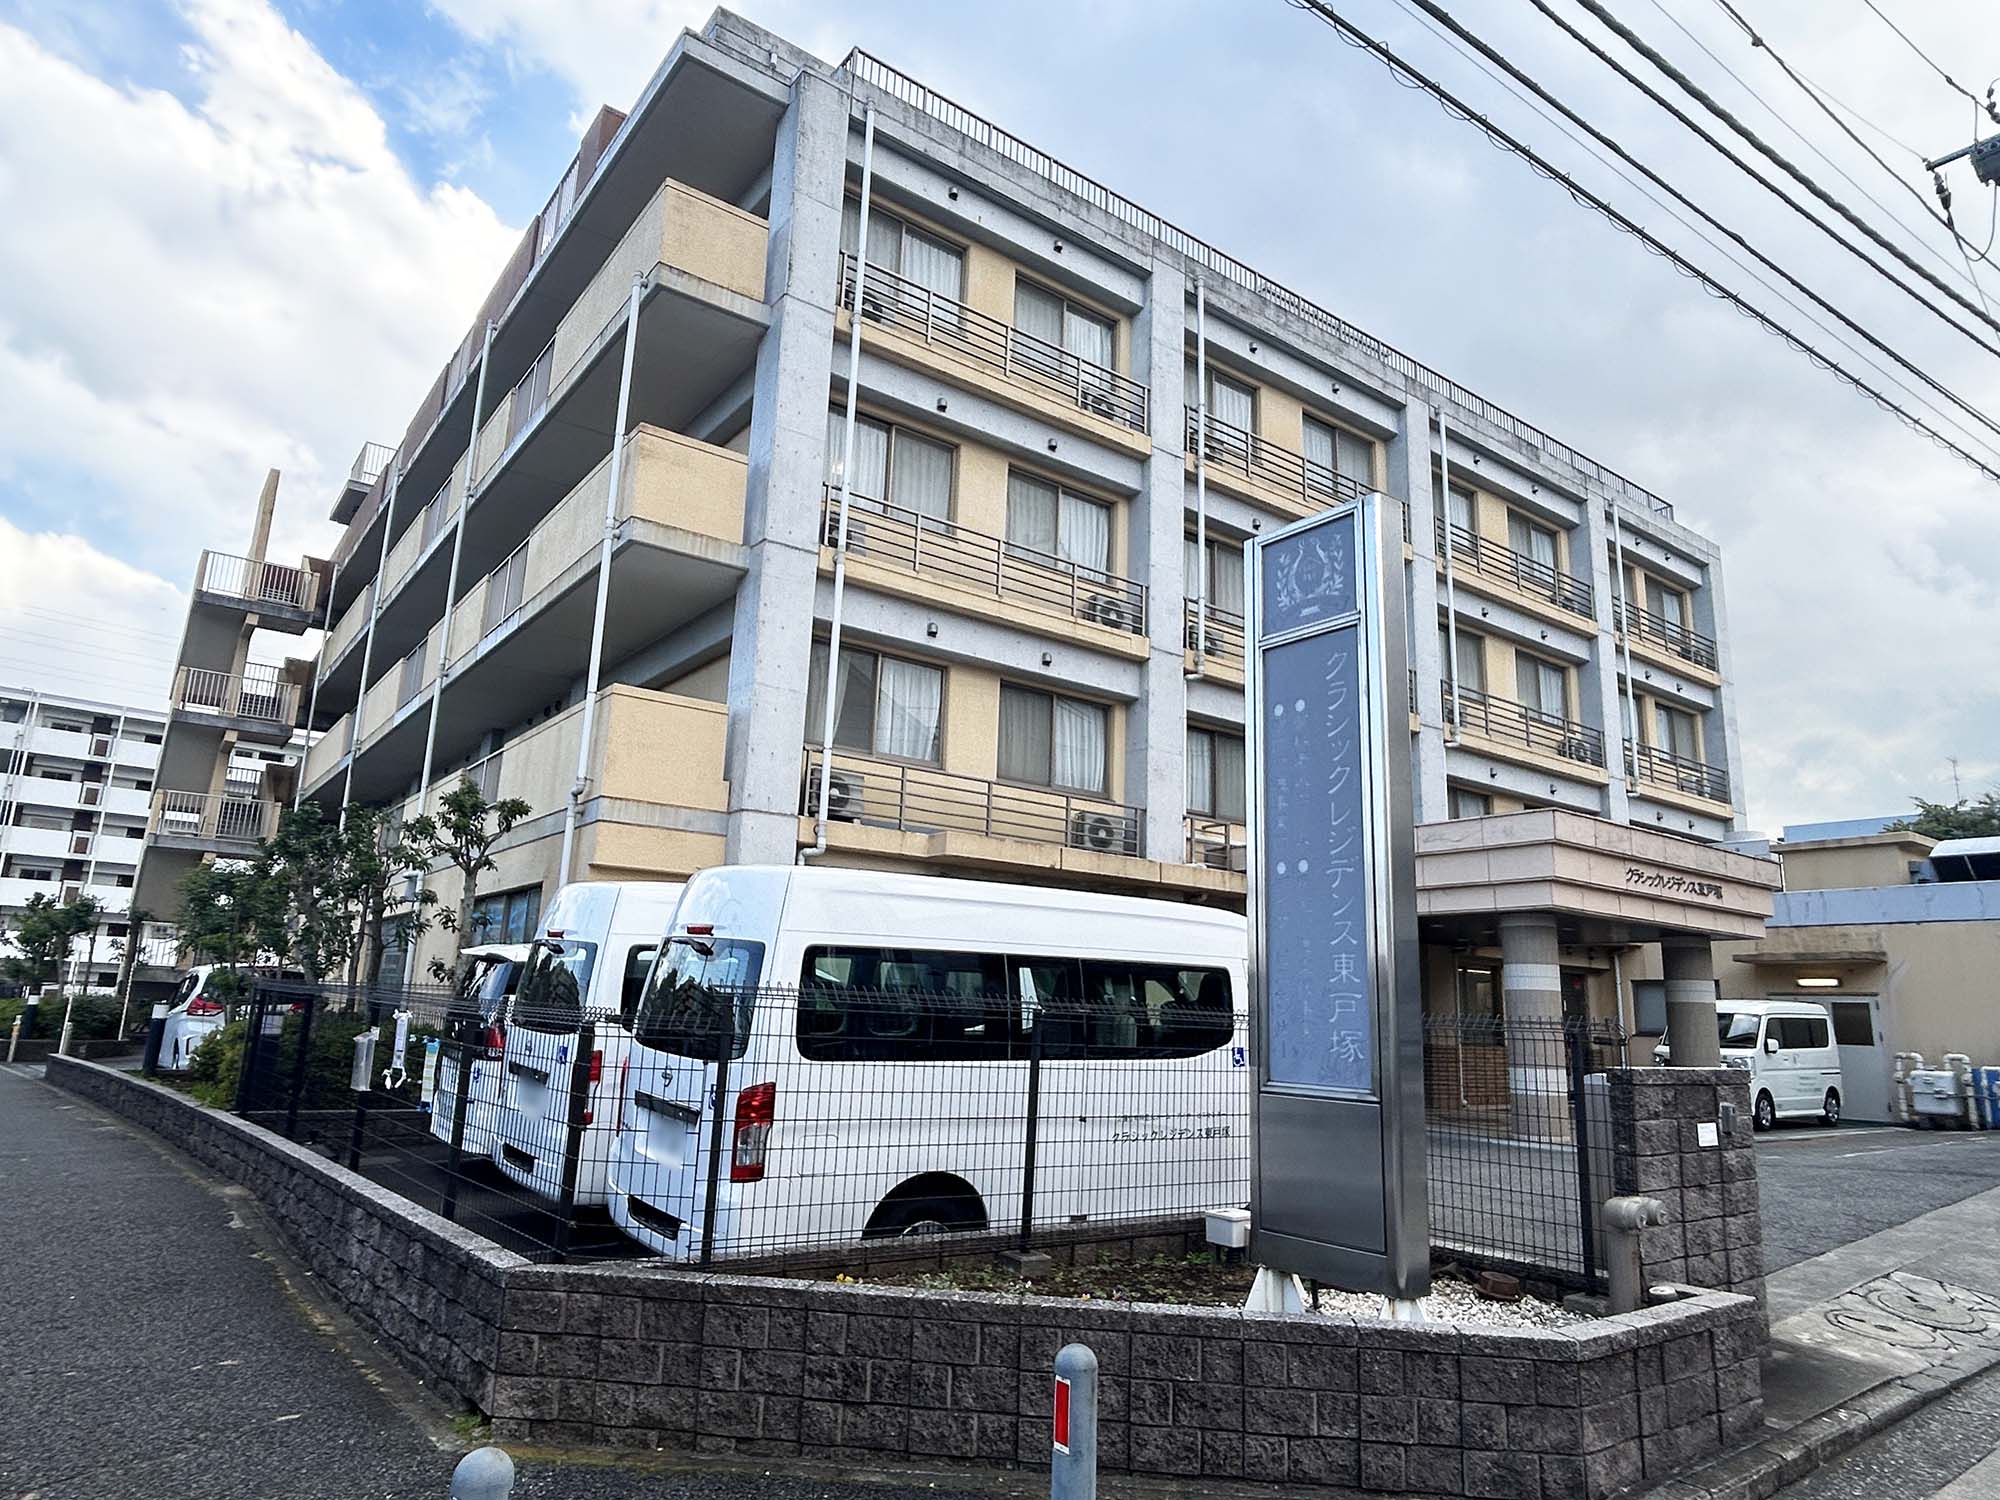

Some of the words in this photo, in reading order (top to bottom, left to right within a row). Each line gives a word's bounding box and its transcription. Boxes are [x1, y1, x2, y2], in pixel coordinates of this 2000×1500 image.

[1325, 651, 1365, 1063] クラシックレジデンス東戸塚
[1626, 868, 1723, 899] クラシックレジデンス東戸塚
